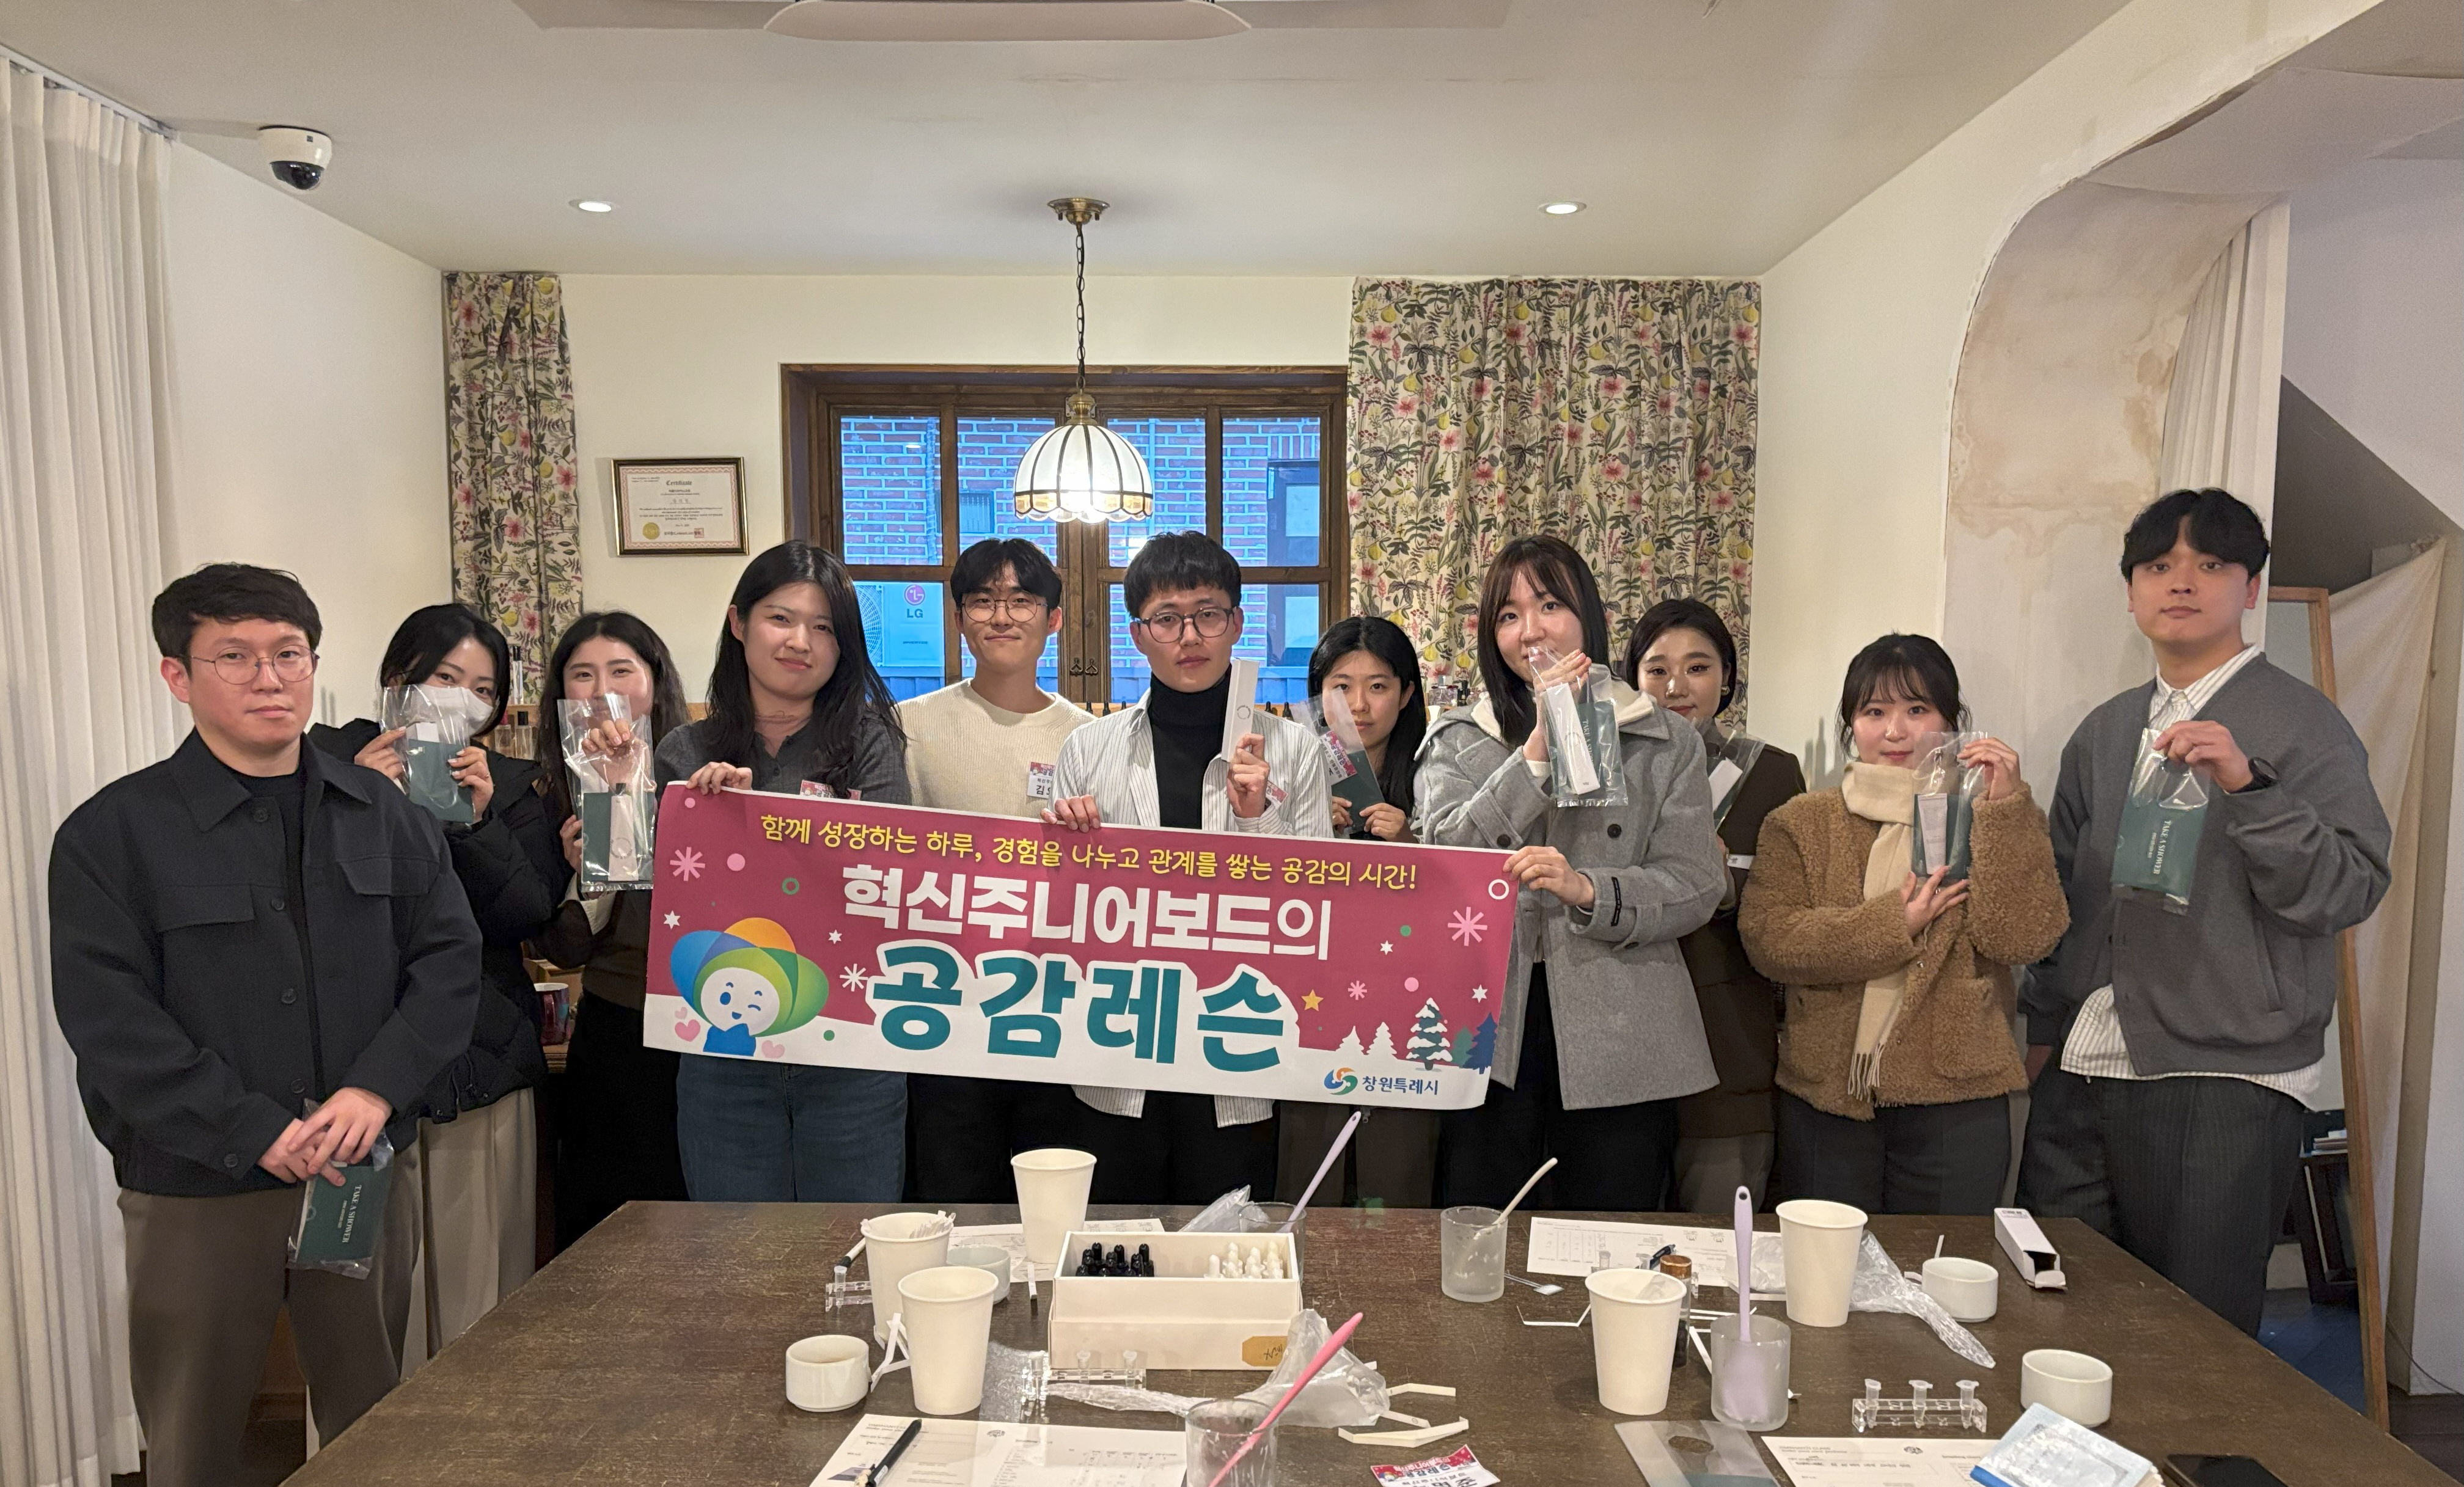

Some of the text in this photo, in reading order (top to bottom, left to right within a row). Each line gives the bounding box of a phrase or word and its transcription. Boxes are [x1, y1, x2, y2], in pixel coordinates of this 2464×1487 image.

[906, 608, 923, 618] LG
[761, 814, 1417, 890] 함께 성장하는 하루, 경험을 나누고 관계를 쌓는 공감의 시간!
[843, 864, 1332, 960] 혁신주니어보드의
[872, 946, 1284, 1073] 공감레슨
[1362, 1076, 1438, 1095] 창원특례시
[352, 1185, 362, 1203] TAKE
[342, 1211, 356, 1243] SHOWER
